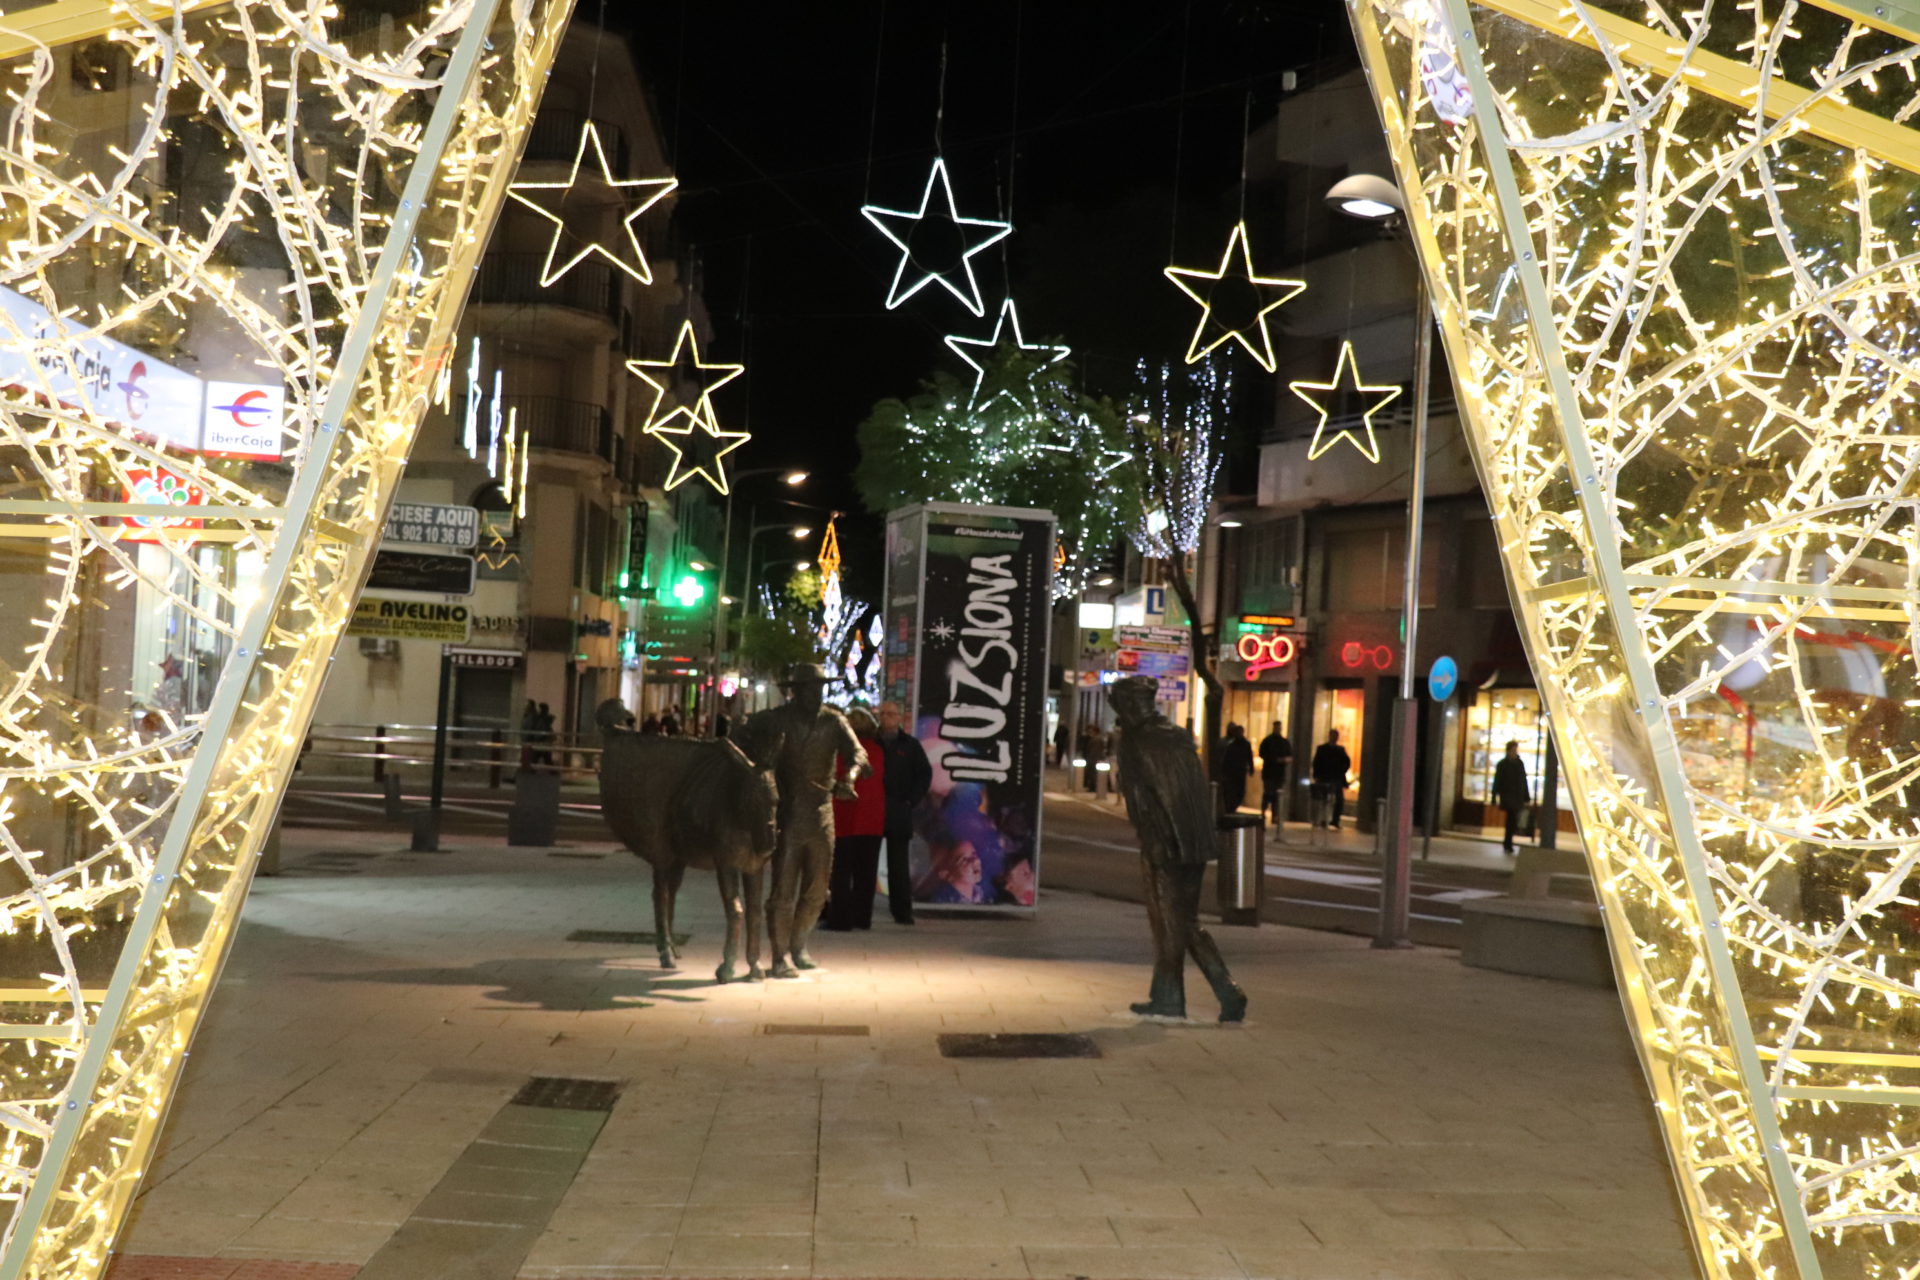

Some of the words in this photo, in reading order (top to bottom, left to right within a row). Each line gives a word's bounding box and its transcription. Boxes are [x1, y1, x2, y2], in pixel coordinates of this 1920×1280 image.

[212, 431, 273, 449] iberCaja
[436, 508, 473, 527] AQUI
[402, 524, 422, 541] 902
[425, 526, 439, 542] 10
[441, 528, 455, 544] 36
[457, 529, 471, 545] 69
[631, 501, 648, 583] MATEO
[380, 600, 468, 622] AVELINO
[940, 554, 1018, 784] ILUZSIONA
